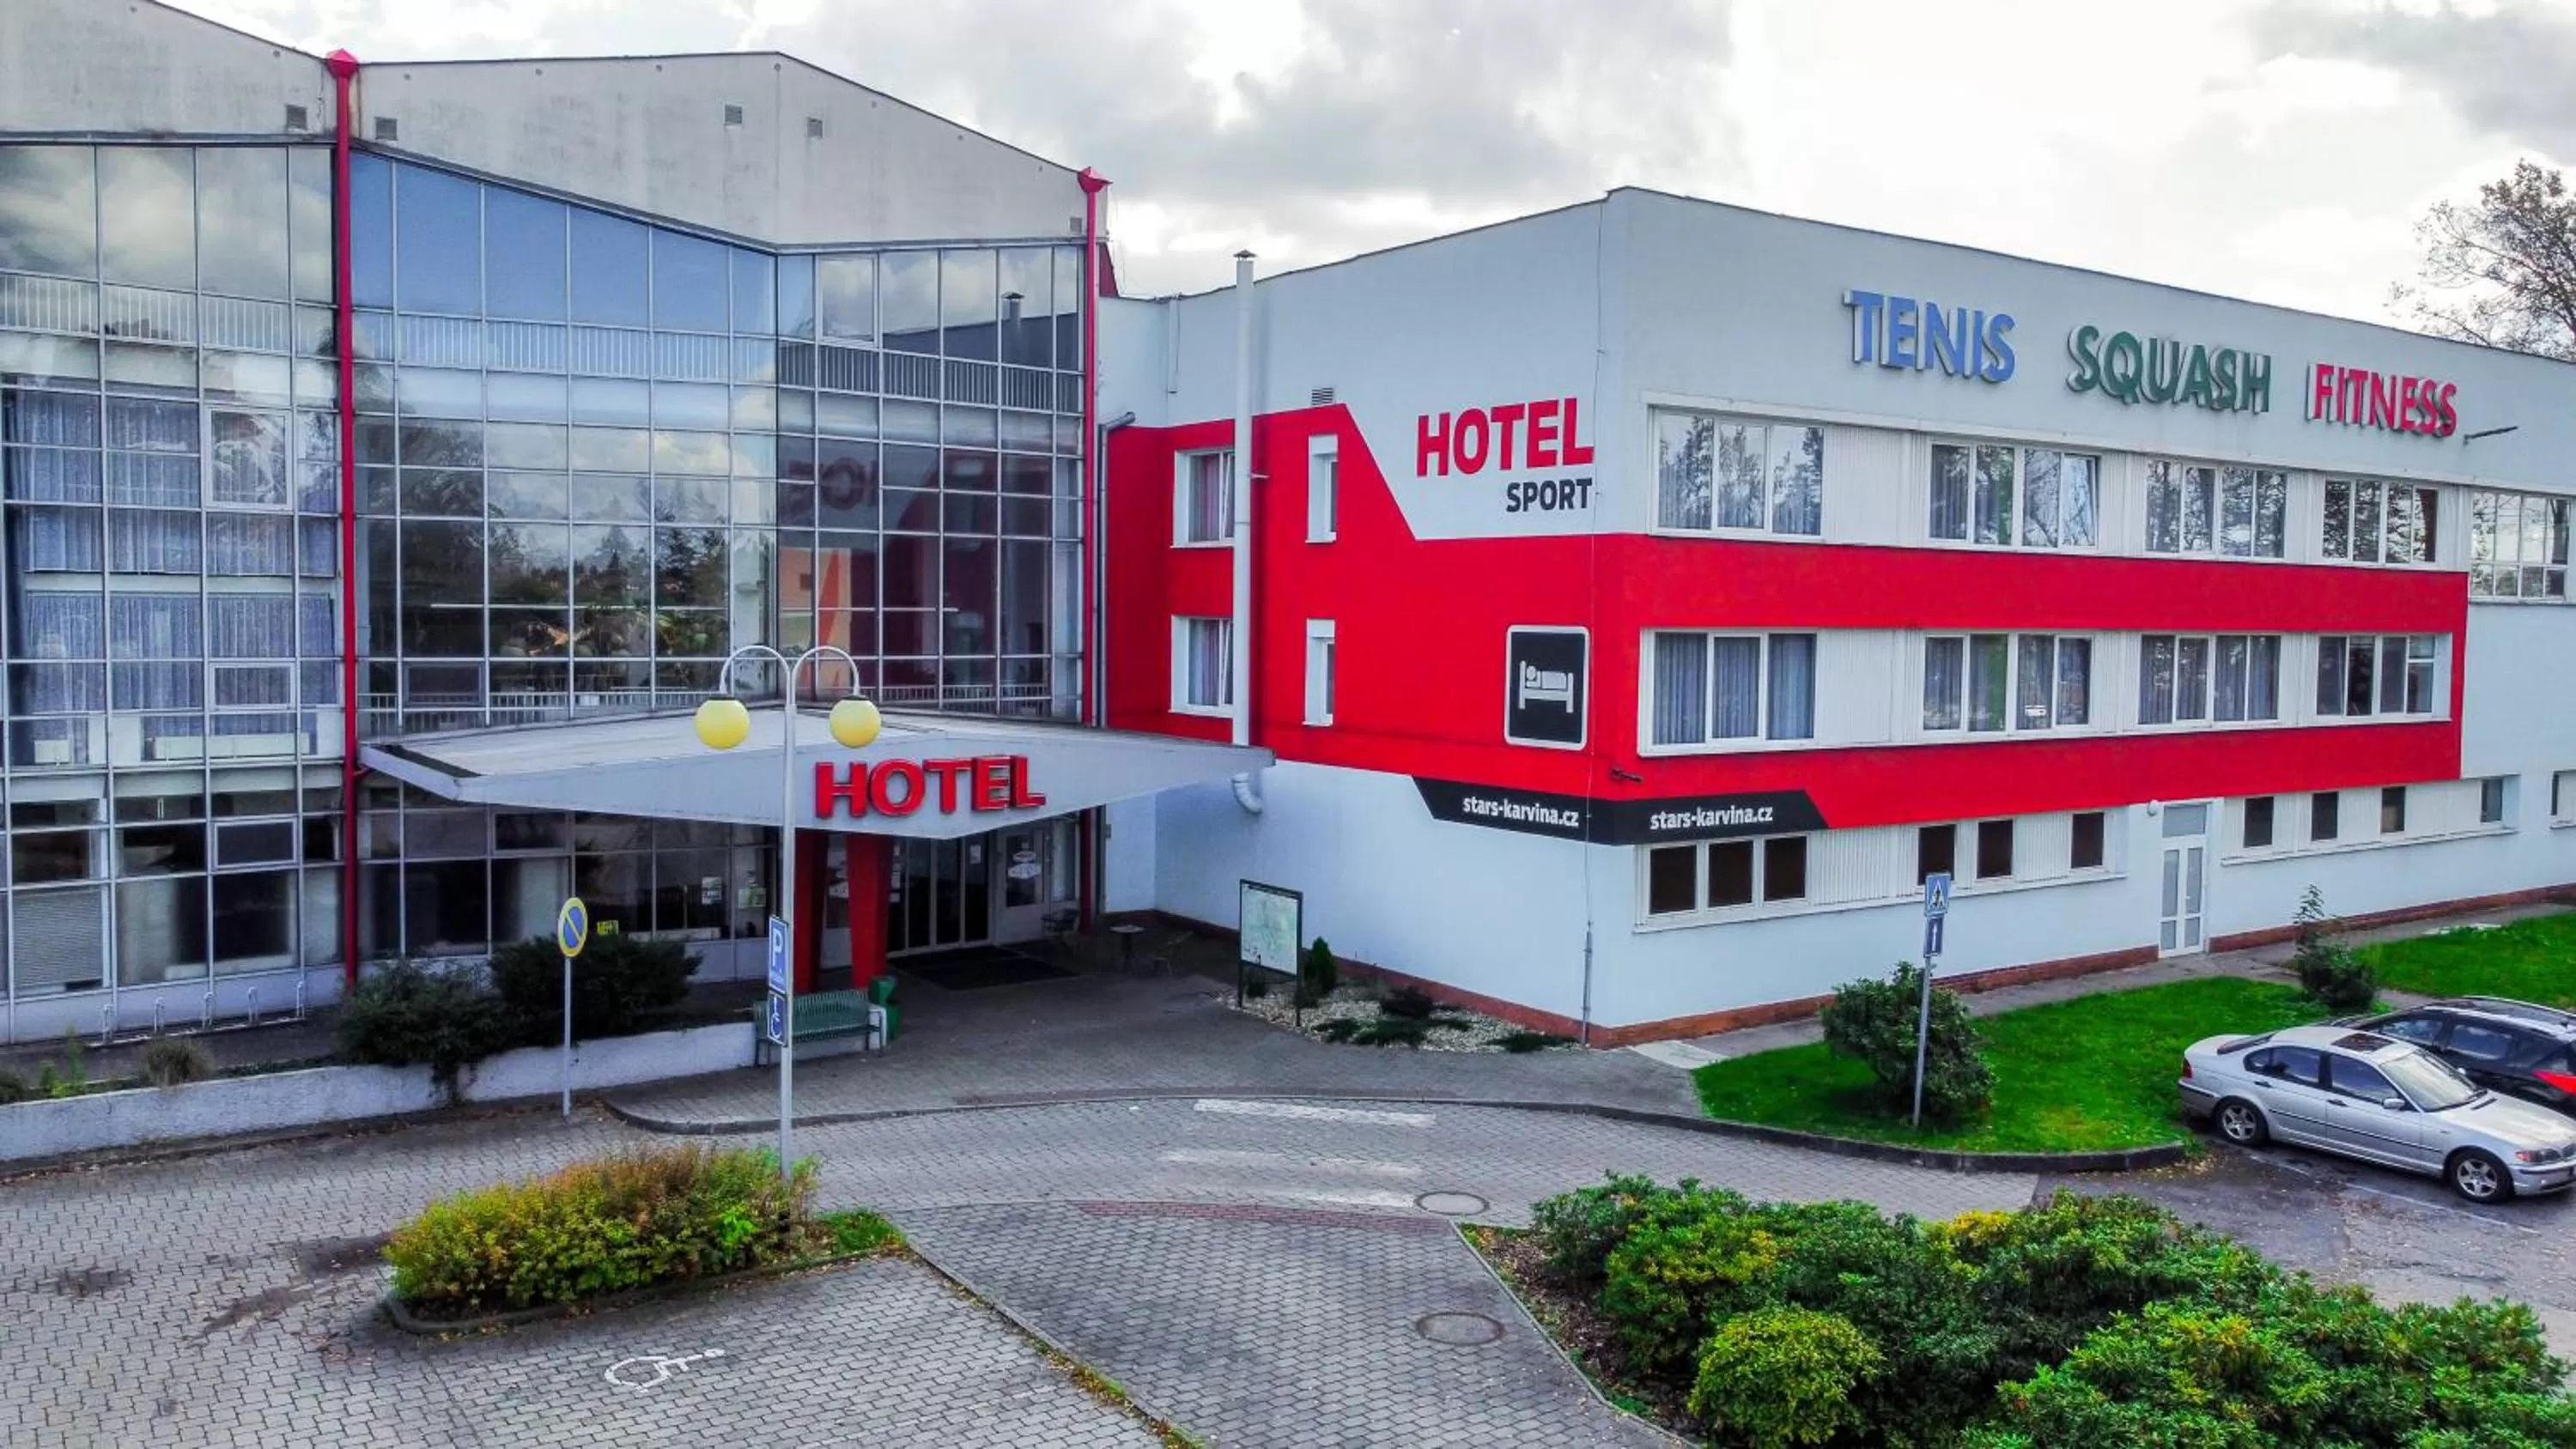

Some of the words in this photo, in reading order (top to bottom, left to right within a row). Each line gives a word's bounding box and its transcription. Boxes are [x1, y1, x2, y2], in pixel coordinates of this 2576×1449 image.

[1844, 290, 2015, 383] TENIS
[2067, 325, 2271, 414] SQUASH
[2306, 363, 2458, 437] FITNESS
[1417, 397, 1595, 477] HOTEL
[1506, 477, 1593, 513] SPORT
[815, 755, 1046, 818] HOTEL
[1462, 796, 1579, 828] stars-karvina.cz
[1649, 804, 1773, 830] stars-karvina.cz
[772, 928, 783, 967] P
